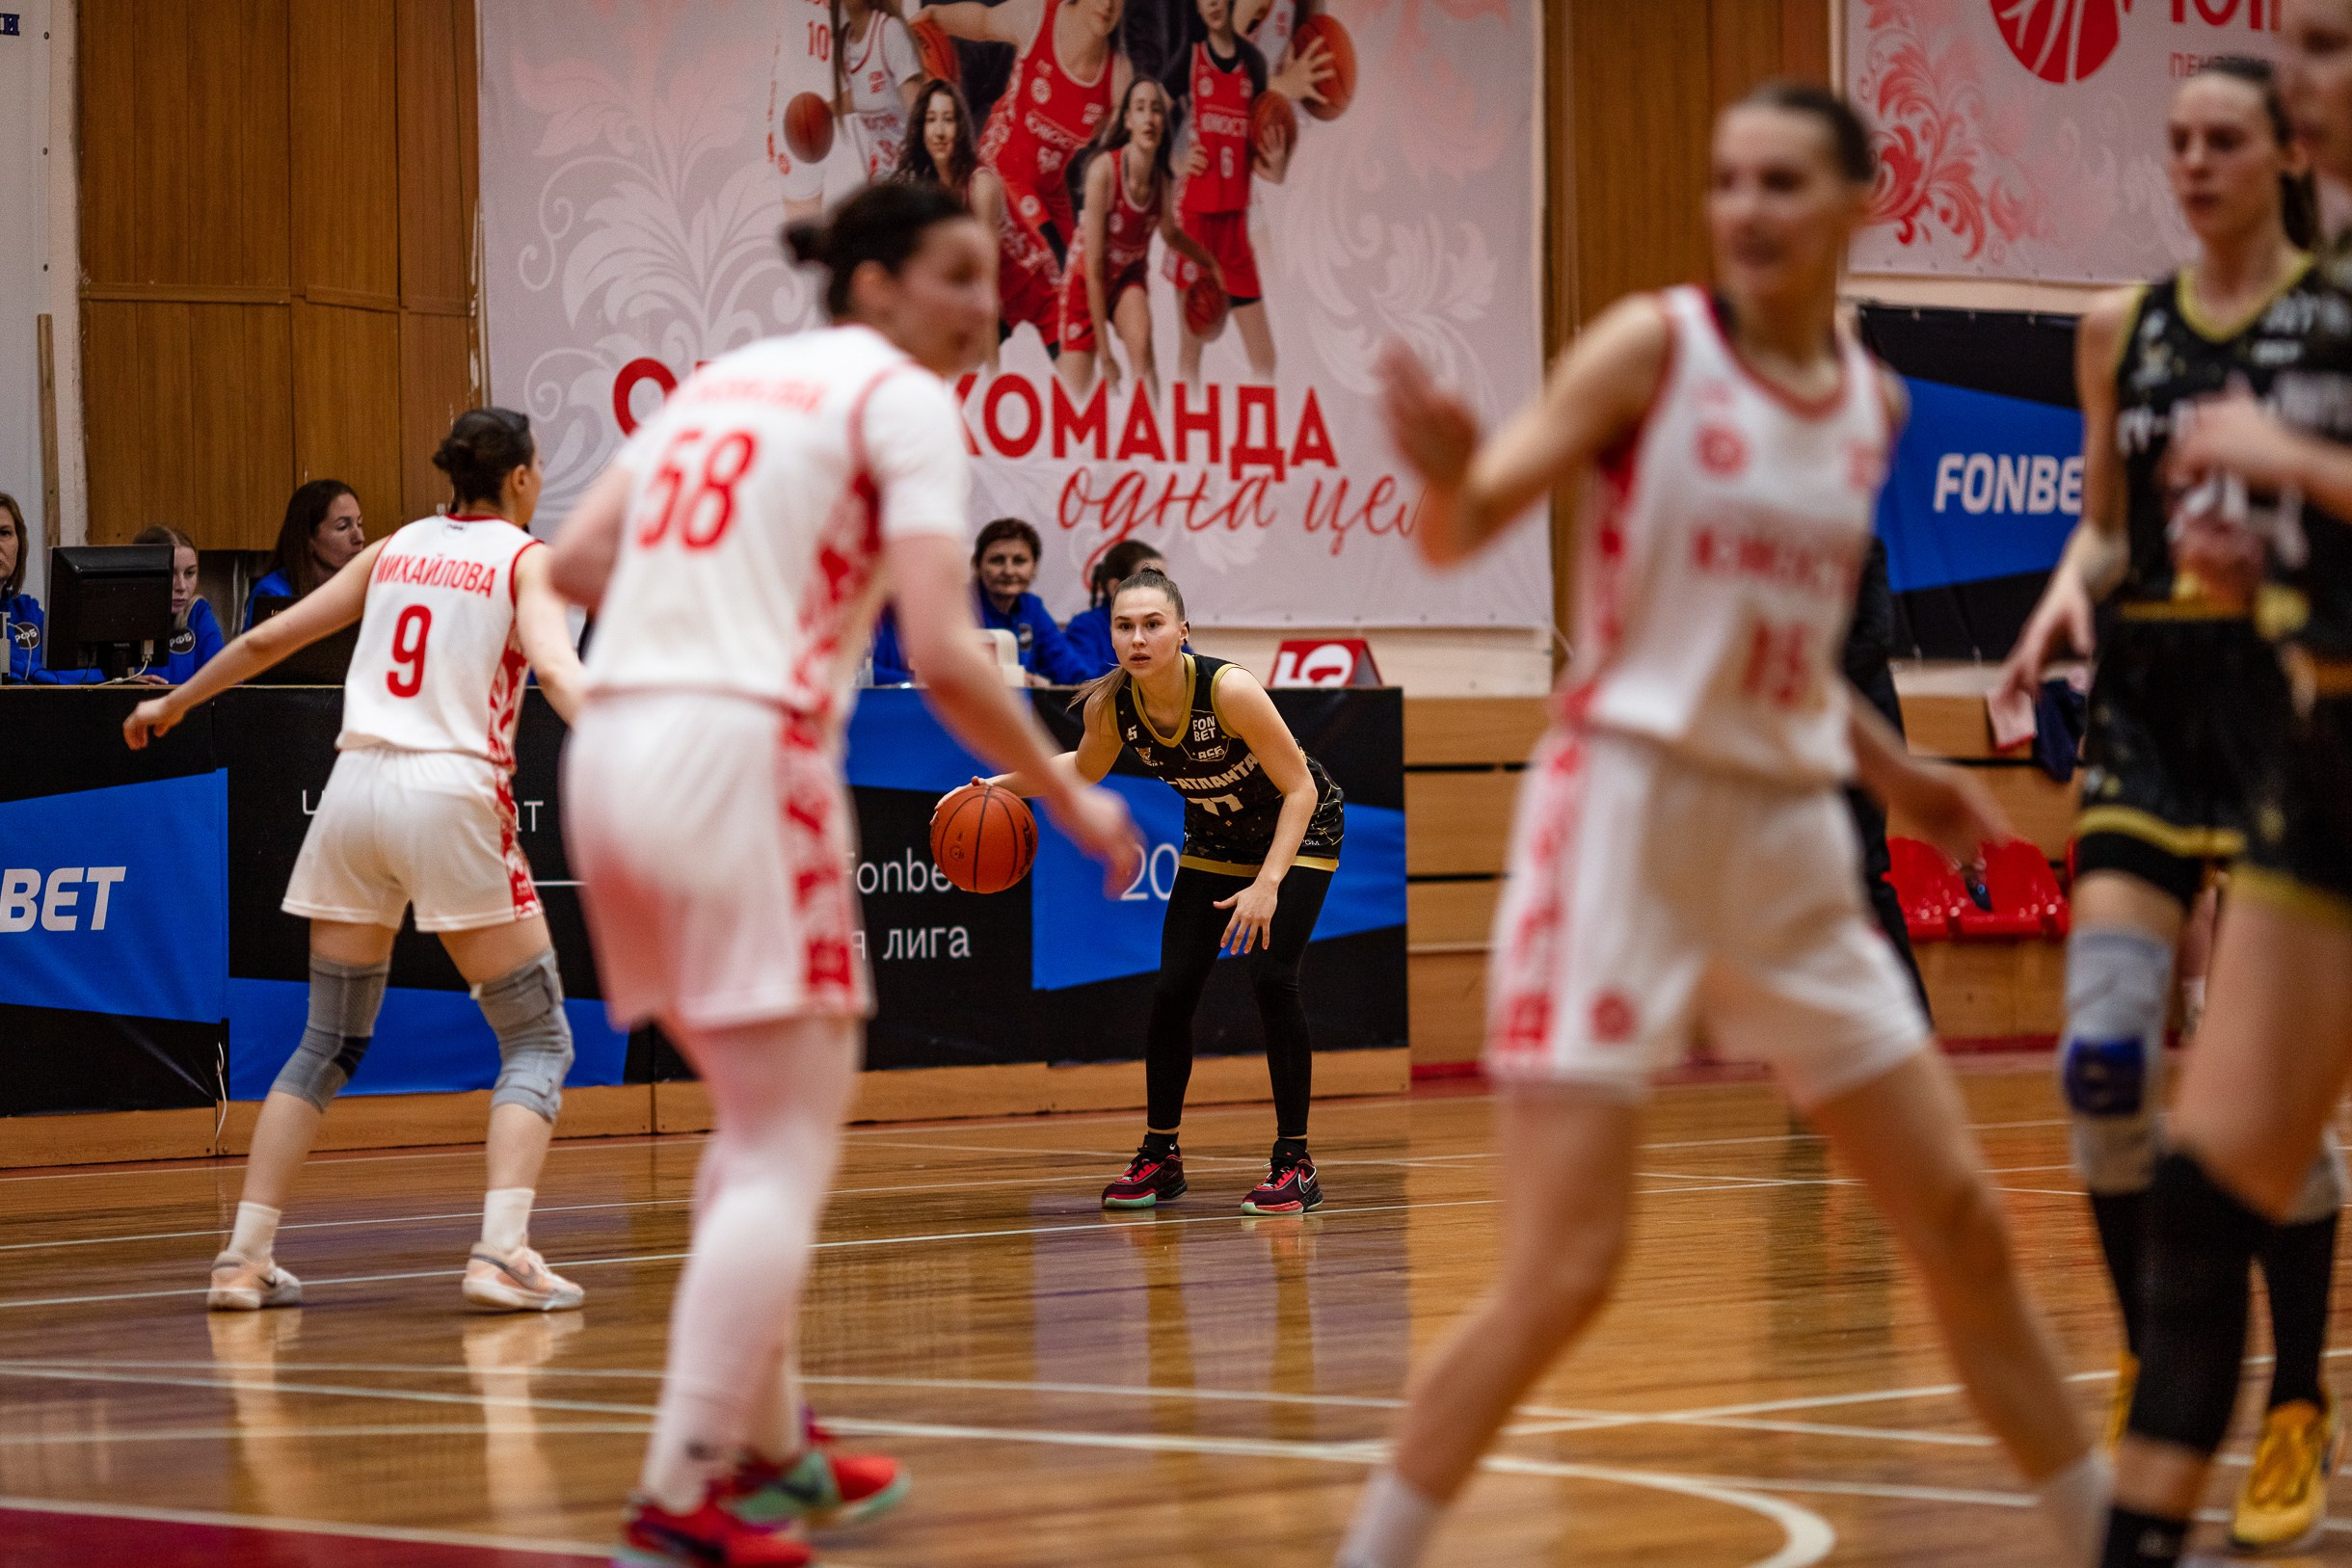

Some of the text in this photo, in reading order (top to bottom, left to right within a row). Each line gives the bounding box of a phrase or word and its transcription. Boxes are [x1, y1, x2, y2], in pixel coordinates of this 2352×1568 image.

[637, 428, 758, 550] 58
[1933, 452, 2085, 516] FONBE
[1056, 465, 1429, 592] одна це
[375, 553, 498, 598] МИХАЙЛОВА
[170, 631, 193, 648] РФБ
[387, 603, 433, 699] 9
[1192, 716, 1216, 731] FON
[1193, 727, 1216, 742] BET
[845, 847, 967, 894] onbe
[0, 865, 127, 933] BET
[883, 925, 972, 960] лига
